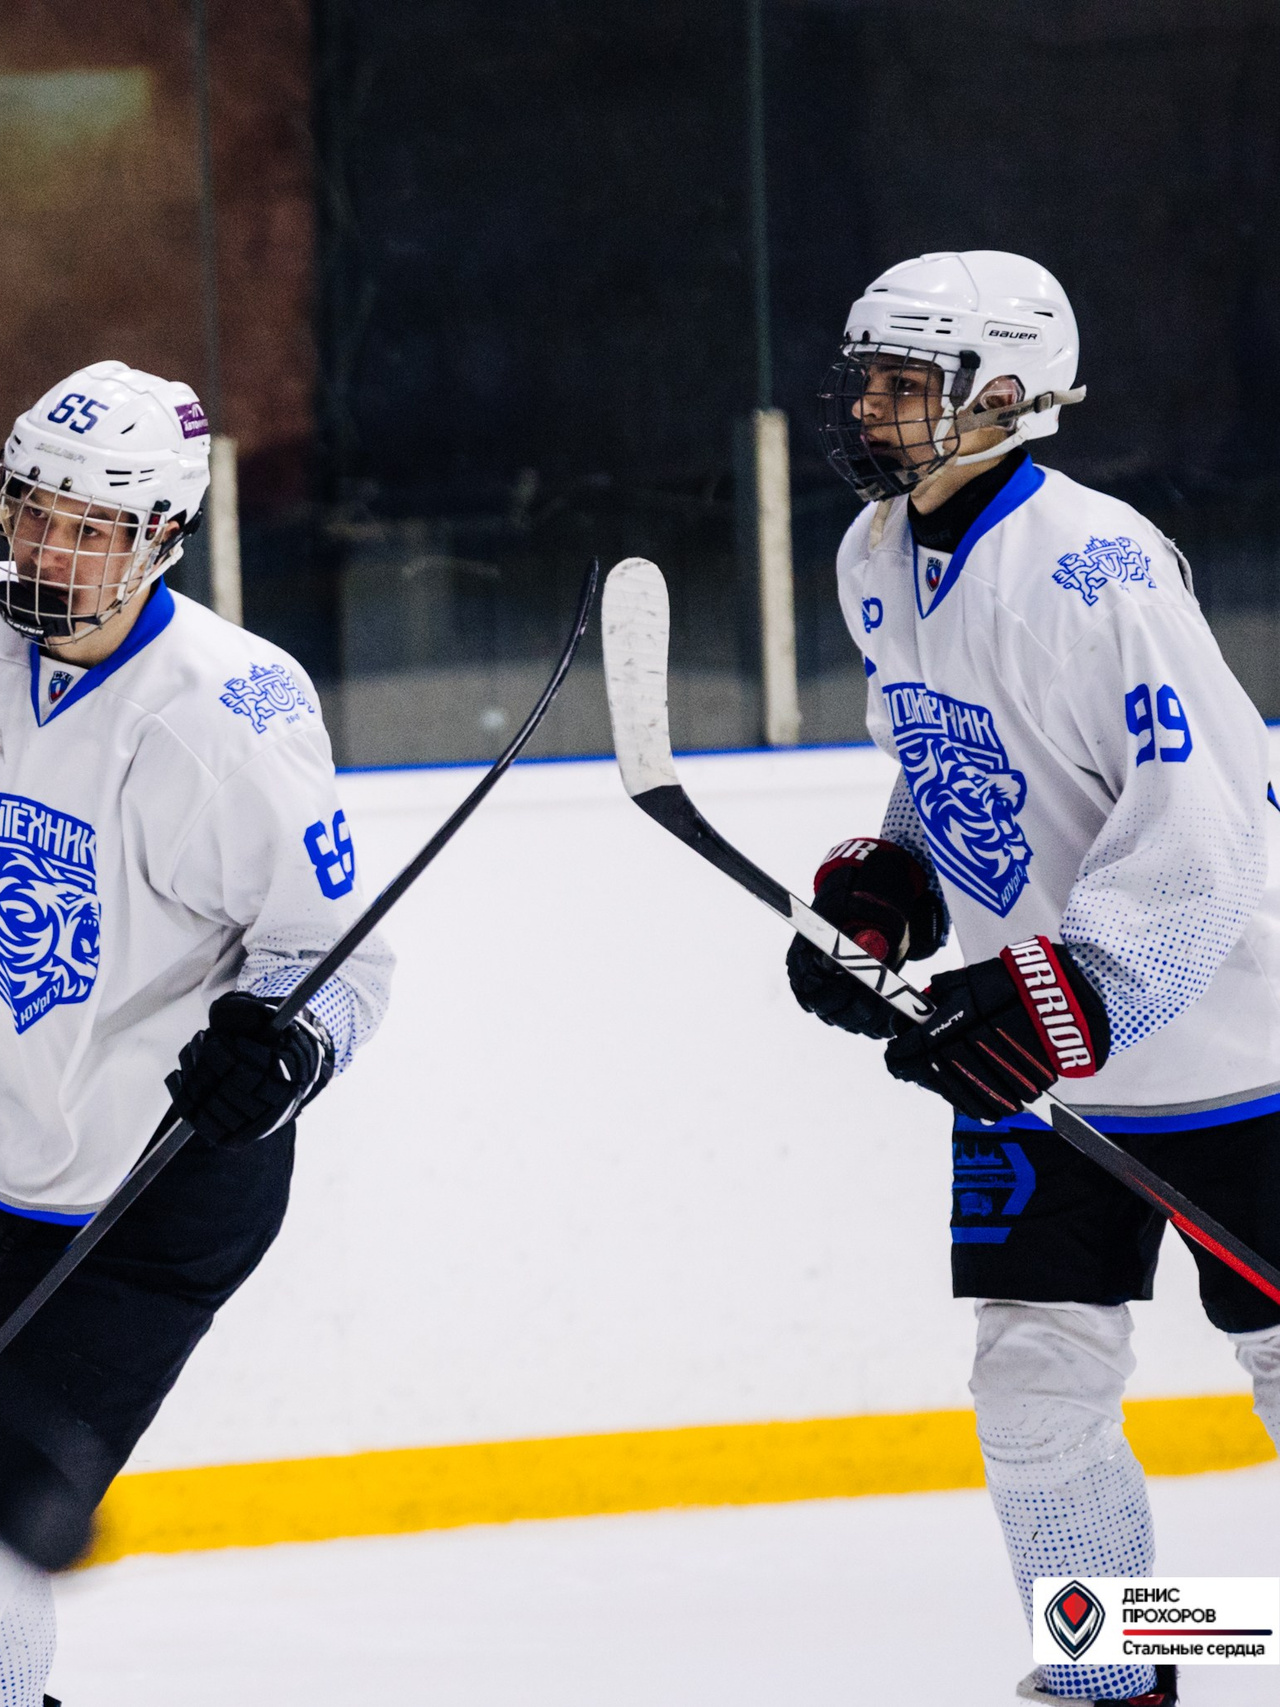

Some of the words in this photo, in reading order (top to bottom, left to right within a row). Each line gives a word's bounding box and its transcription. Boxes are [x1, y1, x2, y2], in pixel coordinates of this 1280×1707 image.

[48, 393, 110, 434] 65
[883, 688, 1001, 750] ПОЛИТЕНИК
[1124, 683, 1193, 767] 99
